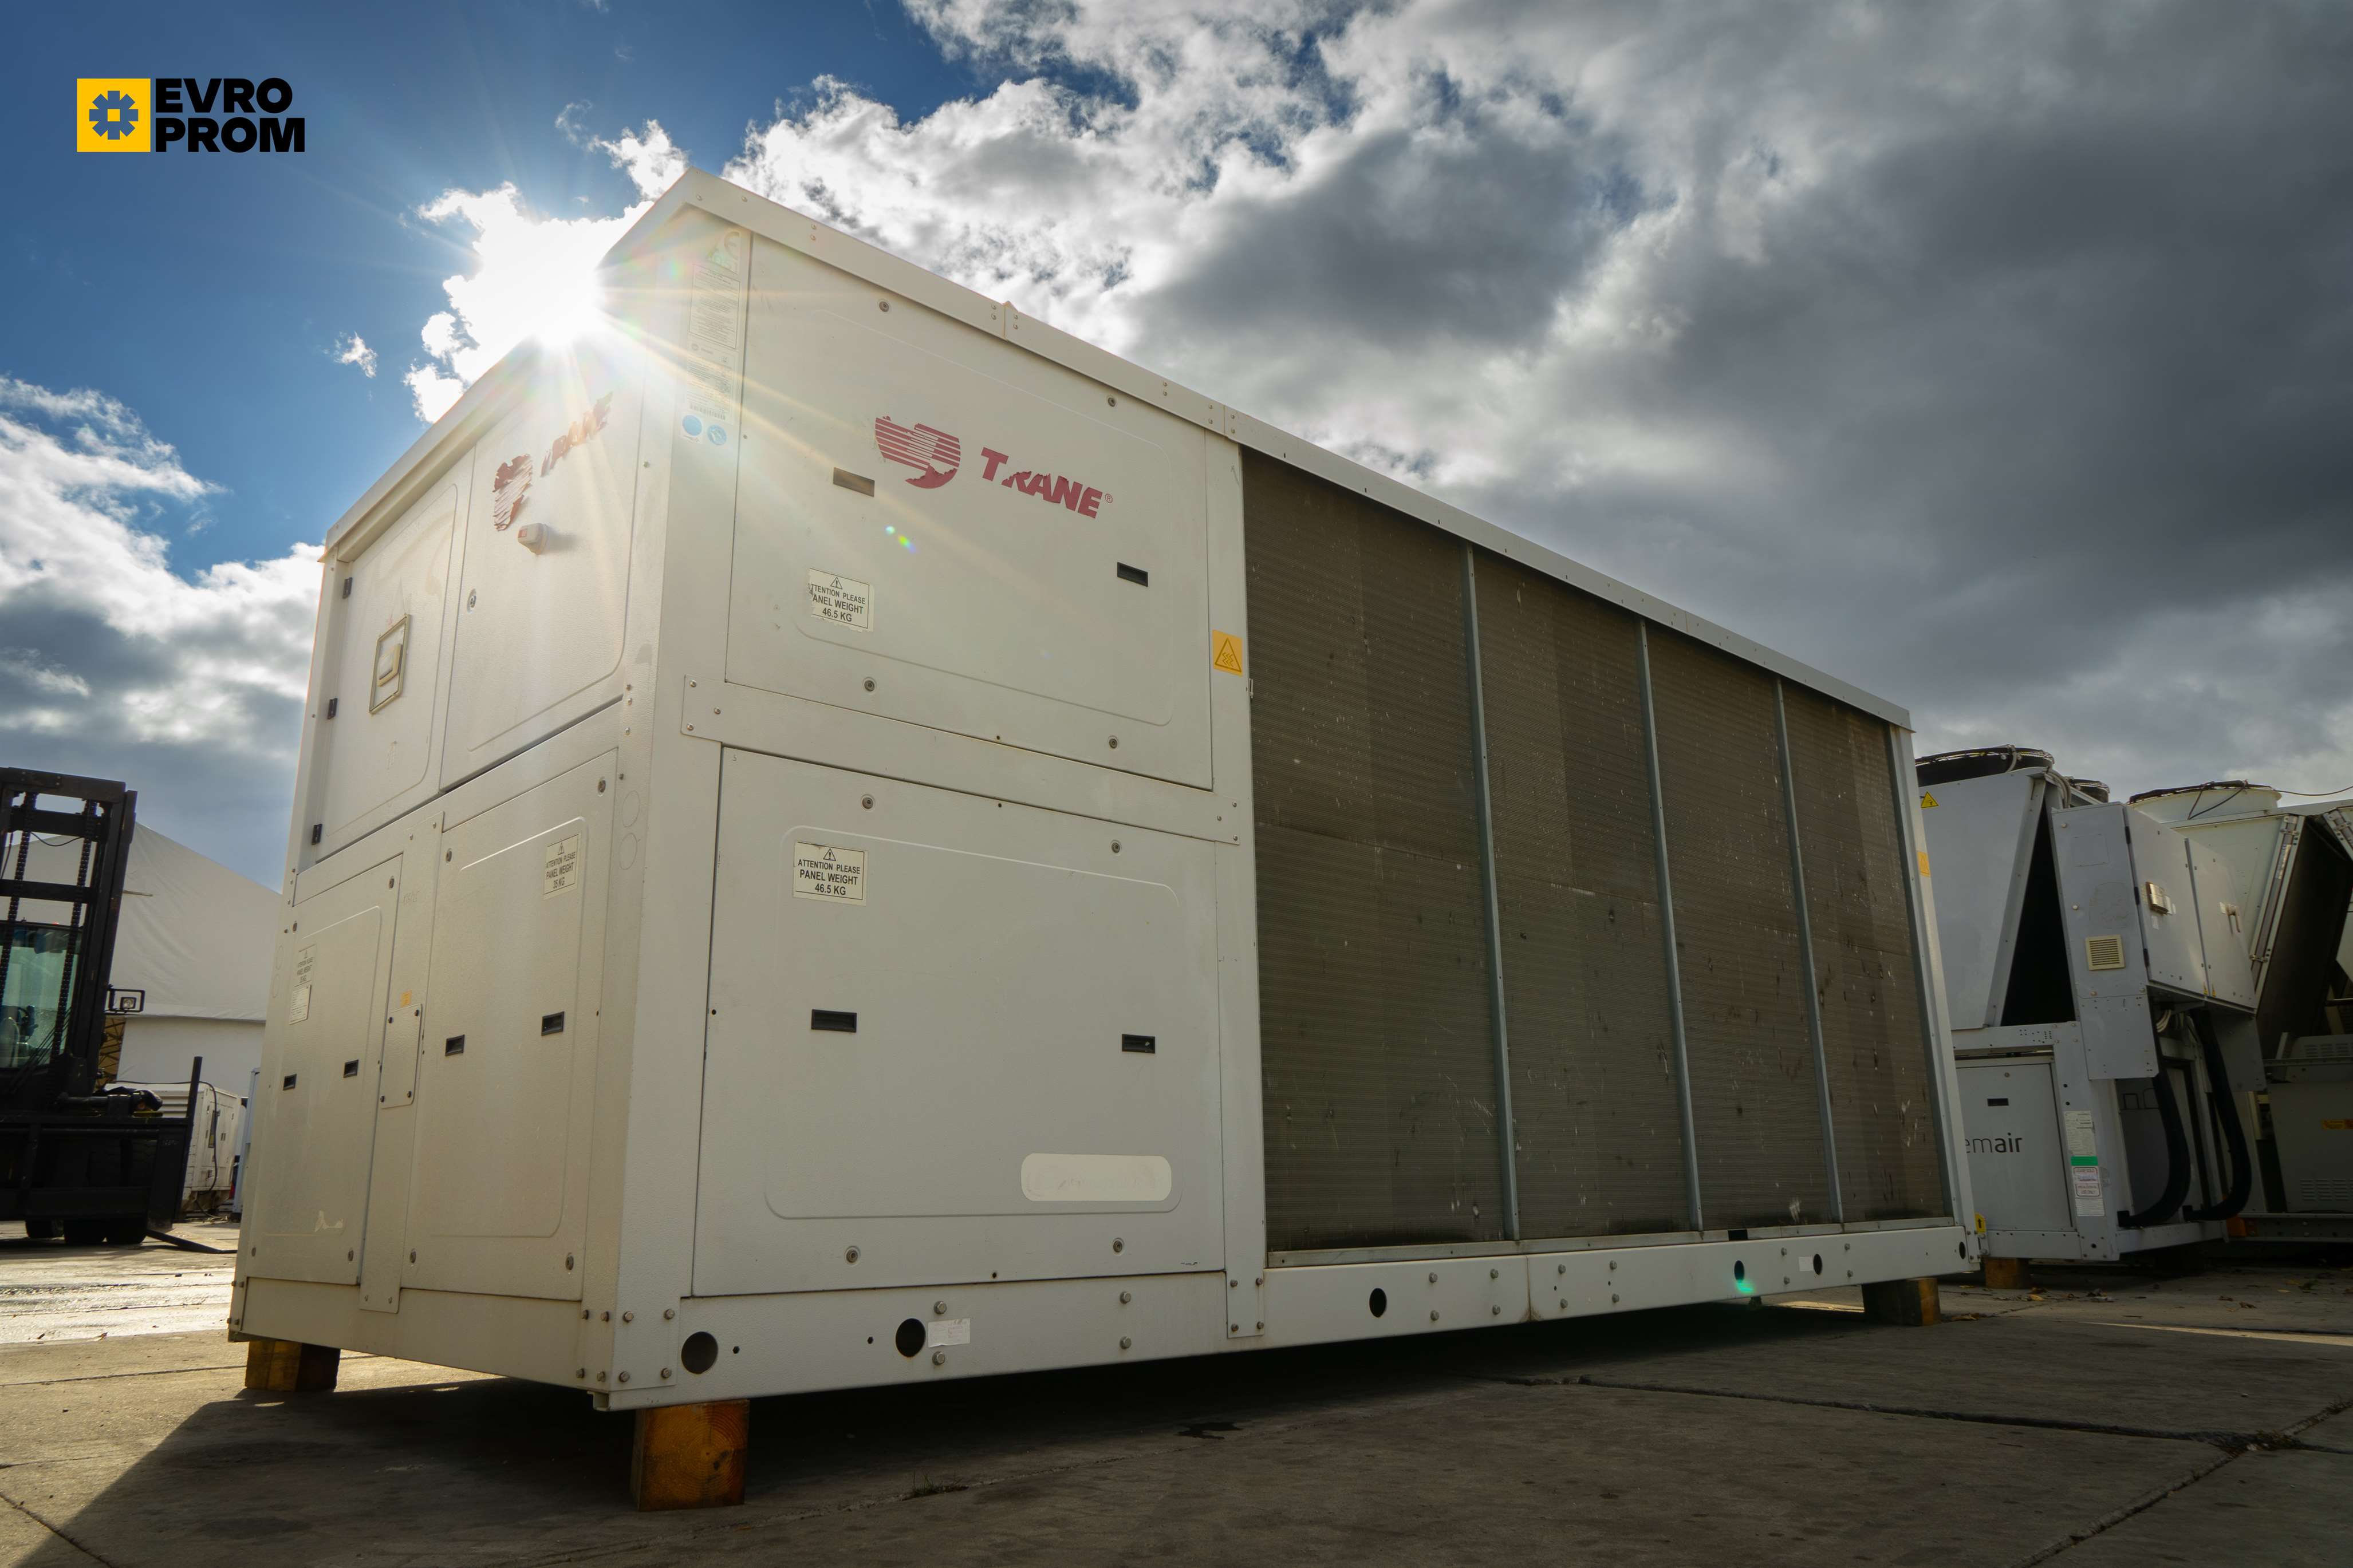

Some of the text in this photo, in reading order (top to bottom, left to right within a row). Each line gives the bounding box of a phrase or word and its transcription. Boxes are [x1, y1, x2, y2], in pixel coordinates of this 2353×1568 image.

[810, 583, 865, 605] TTENTION PLEASE
[812, 594, 864, 614] ANEL WEIGHT
[822, 607, 852, 622] 46.5 KG
[798, 859, 861, 874] ATTENTION PLEASE
[799, 869, 858, 886] PANEL WEIGHT
[815, 883, 846, 895] 46.5 KG
